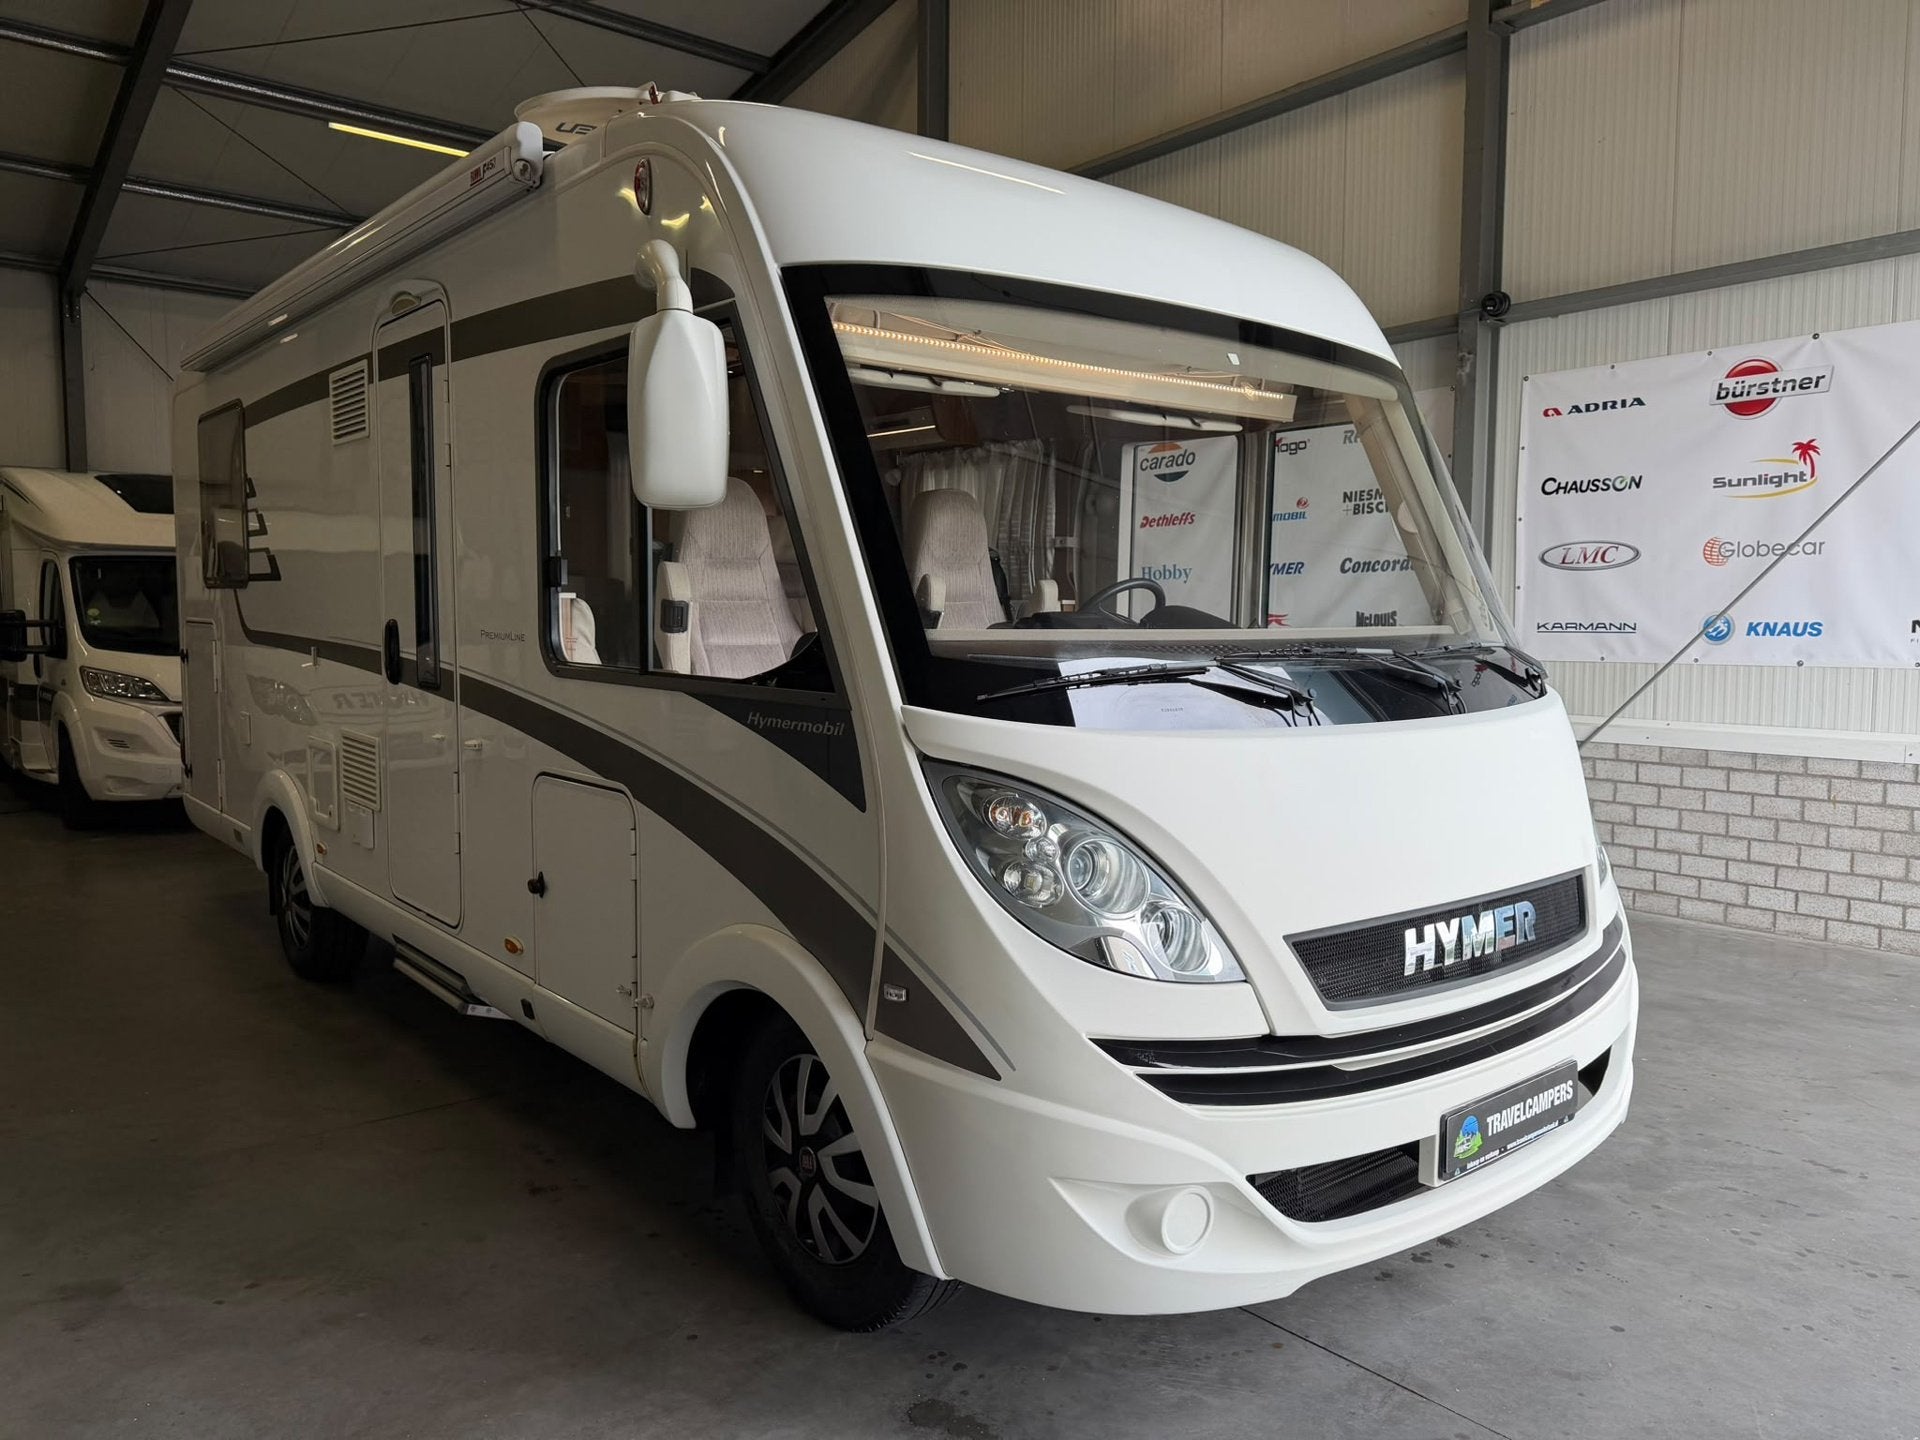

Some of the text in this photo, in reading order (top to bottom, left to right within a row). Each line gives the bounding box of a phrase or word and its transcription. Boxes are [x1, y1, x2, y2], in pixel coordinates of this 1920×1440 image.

[1715, 371, 1827, 401] bürstner
[1567, 396, 1647, 416] ADRIA
[1140, 450, 1196, 472] carado
[1712, 470, 1808, 489] Sunlight
[1140, 511, 1196, 529] Dethleffs
[1559, 545, 1619, 566] LMC
[1717, 540, 1826, 559] Globecar
[1140, 564, 1193, 584] Hobby
[1536, 621, 1637, 632] KARMANN
[1745, 620, 1824, 638] KNAUS
[746, 710, 846, 738] Hymermobil
[1403, 900, 1537, 977] HYMER
[1486, 1079, 1574, 1138] TRAVELCAMPERS
